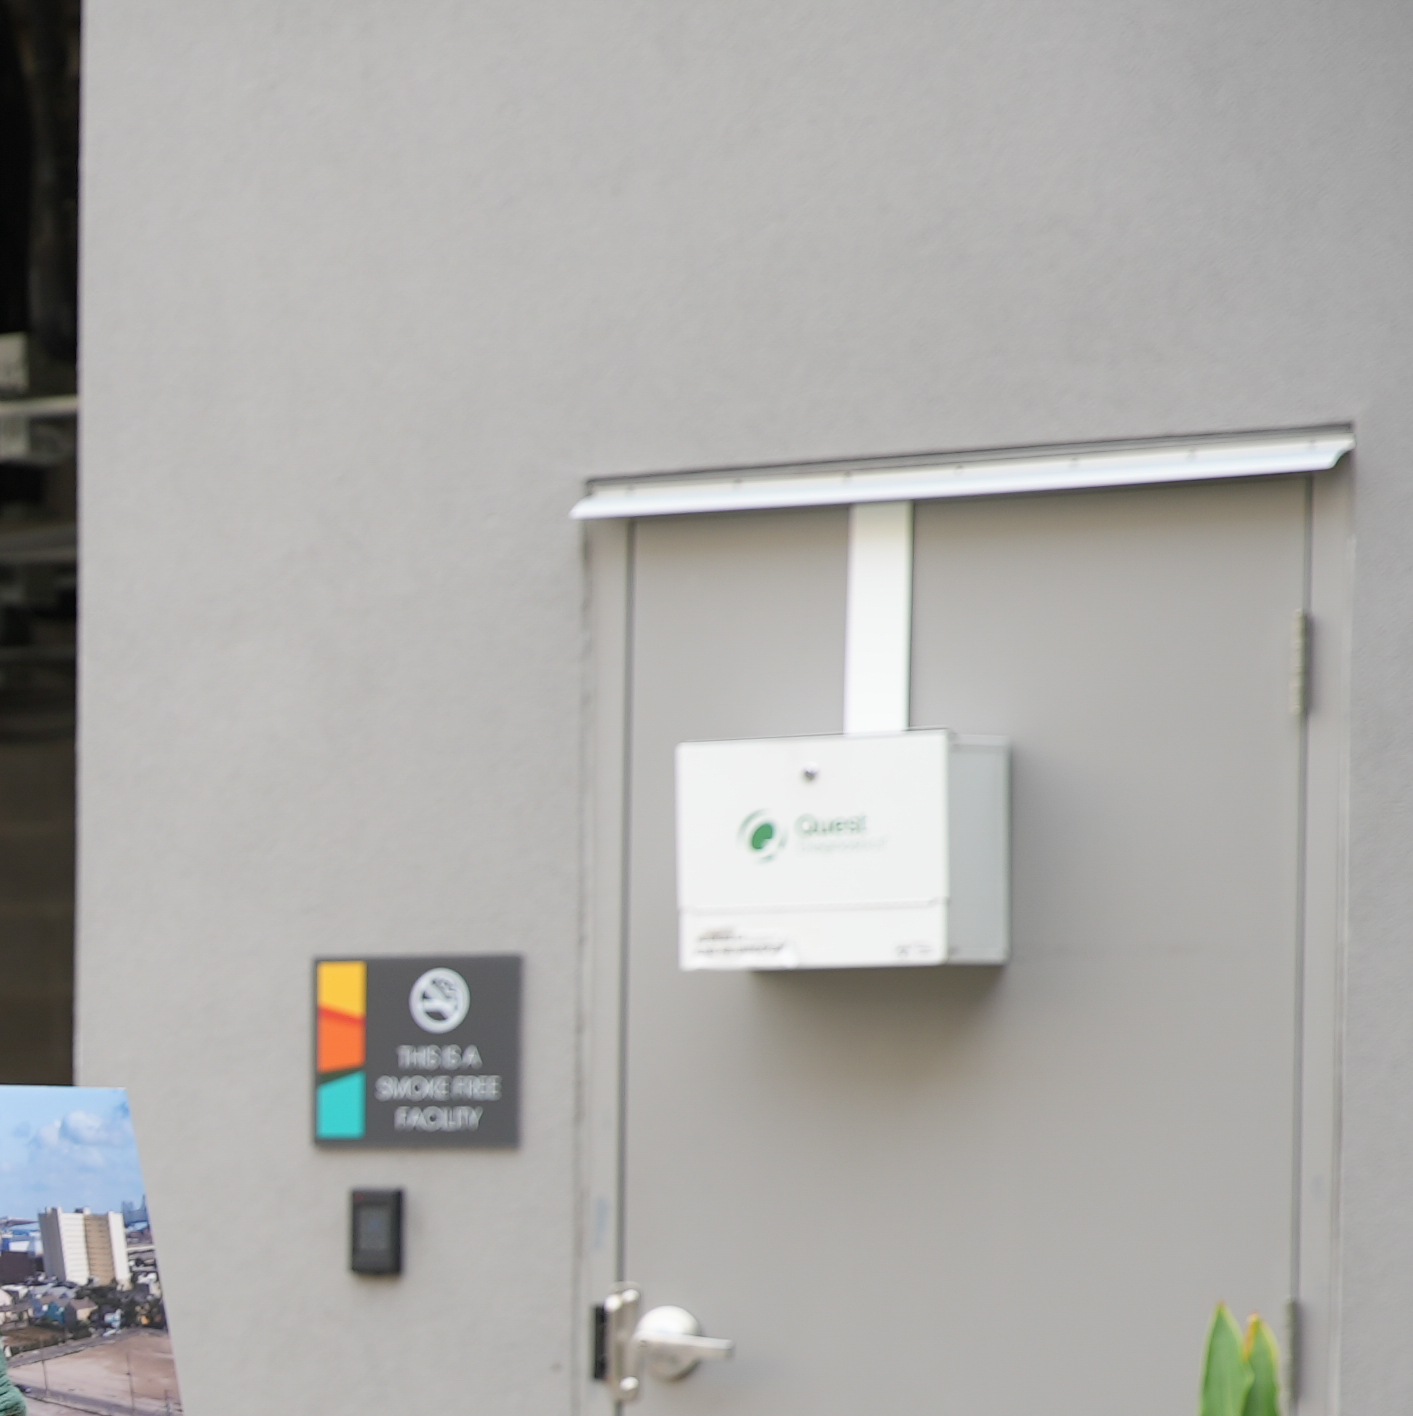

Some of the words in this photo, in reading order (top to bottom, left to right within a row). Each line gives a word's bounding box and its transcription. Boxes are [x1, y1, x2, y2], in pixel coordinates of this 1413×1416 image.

[396, 1045, 441, 1070] THIS
[462, 1045, 482, 1069] A
[375, 1075, 451, 1101] SMOKE
[394, 1106, 483, 1132] FACILITY
